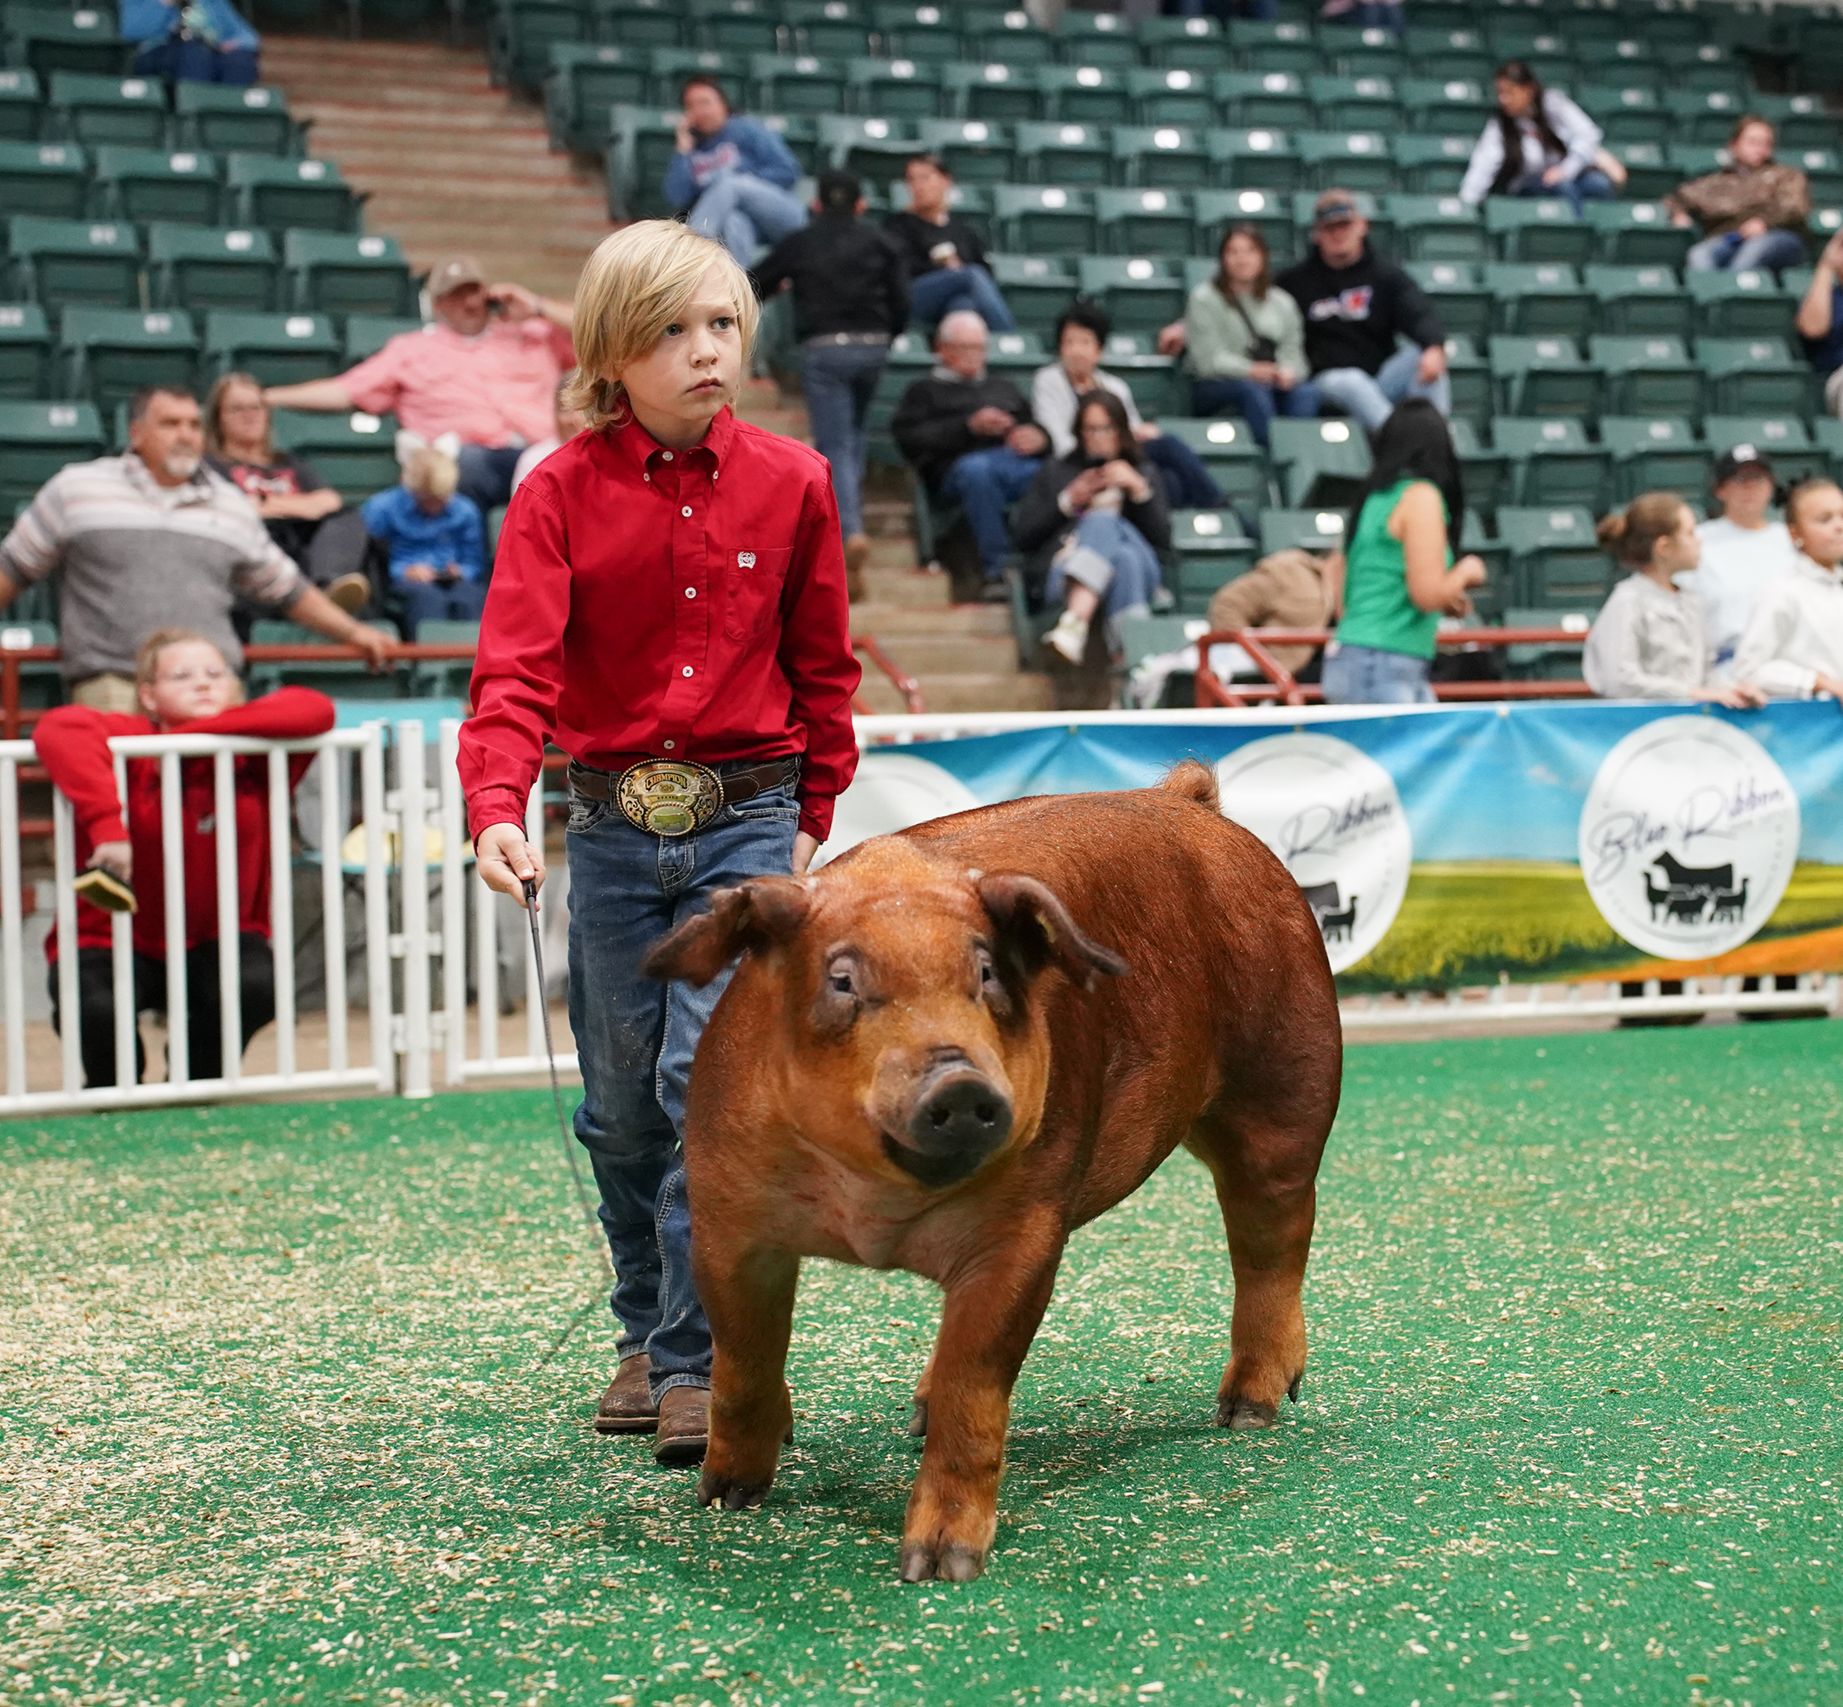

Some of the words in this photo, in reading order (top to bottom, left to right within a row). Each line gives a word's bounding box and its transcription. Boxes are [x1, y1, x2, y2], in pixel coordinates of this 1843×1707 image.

[646, 773, 687, 789] CHAMPION
[1589, 810, 1668, 885] Blue
[1675, 778, 1785, 847] Ribbon
